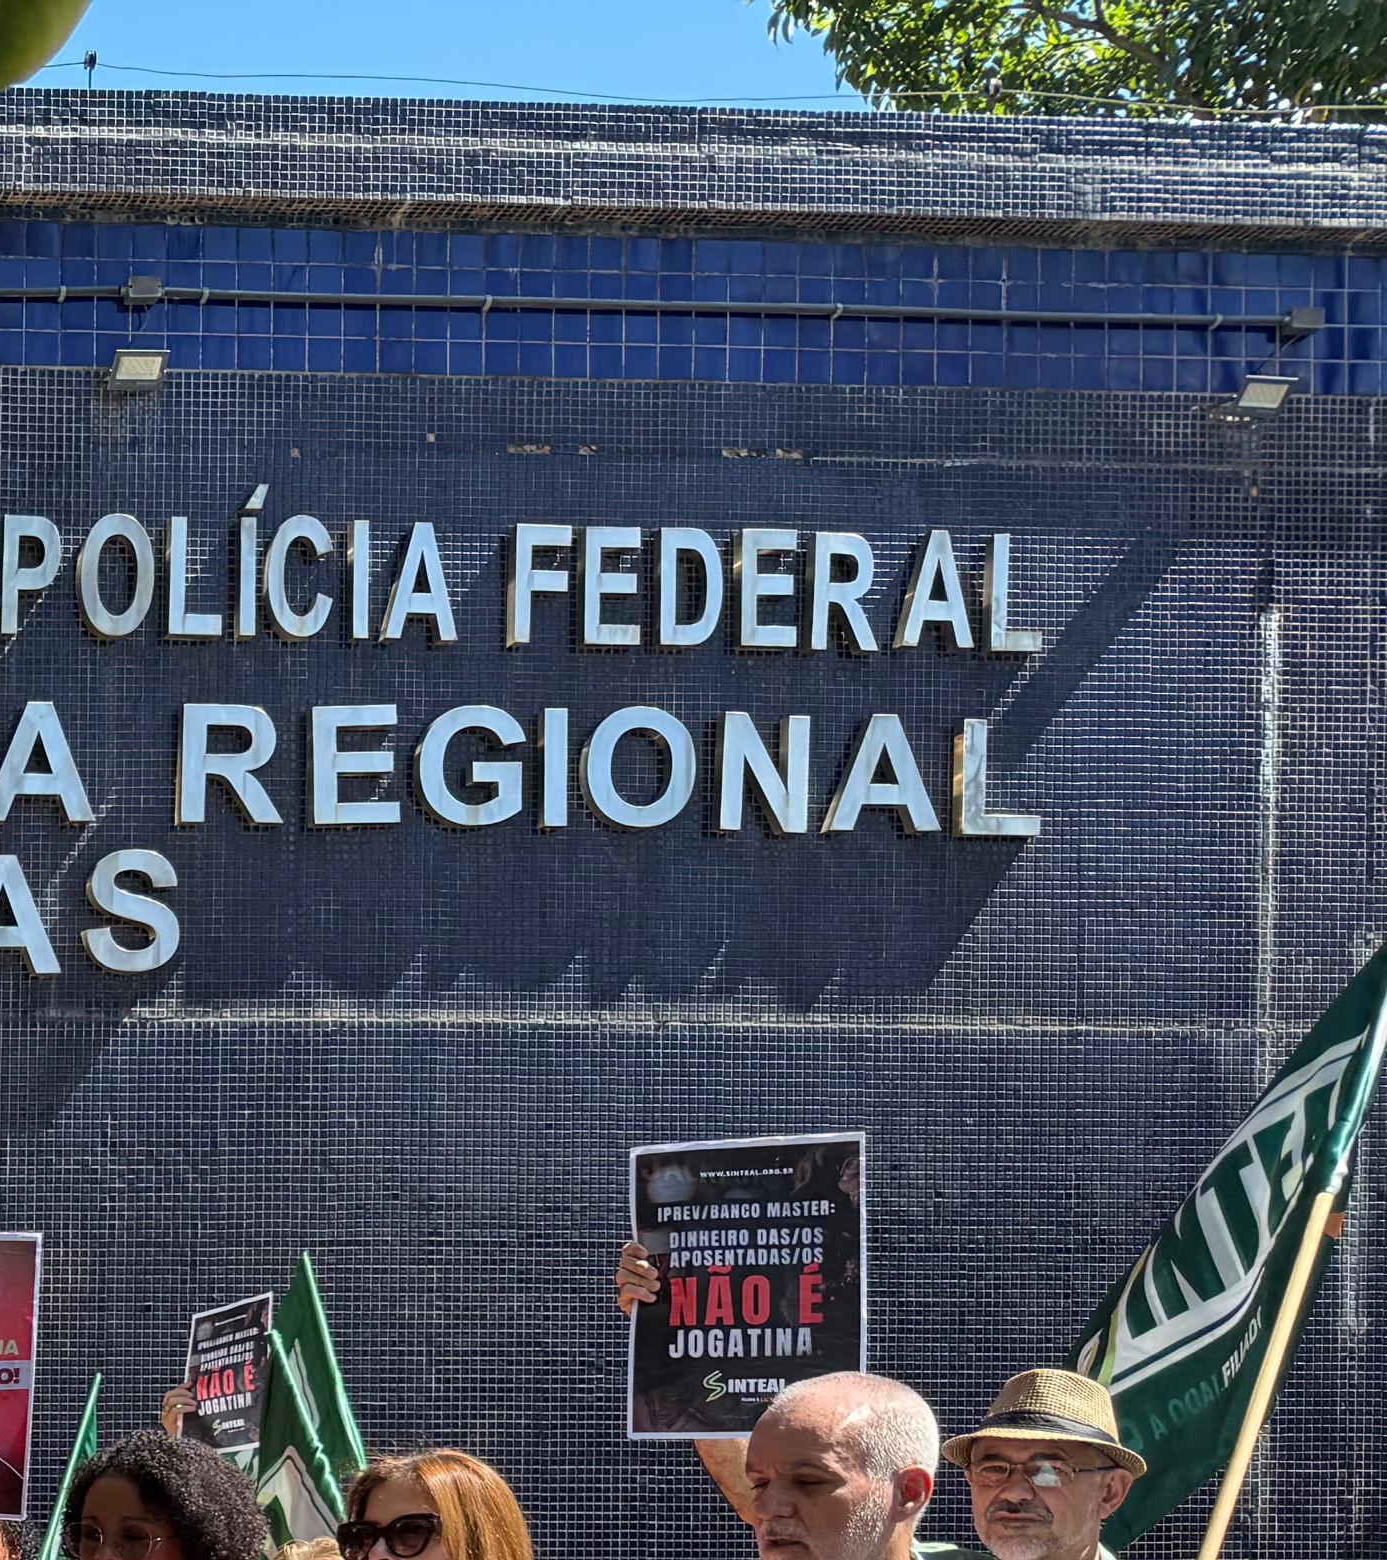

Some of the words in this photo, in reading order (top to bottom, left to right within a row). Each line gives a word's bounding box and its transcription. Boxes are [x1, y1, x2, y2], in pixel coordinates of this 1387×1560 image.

[0, 483, 459, 643] POLÍCIA
[506, 522, 1043, 653] FEDERAL
[175, 702, 1042, 839] REGIONAL
[657, 1202, 760, 1222] IPREV/BANCO
[767, 1200, 835, 1217] MASTER:
[670, 1230, 749, 1248] DINHEIRO
[757, 1227, 824, 1246] DAS/OS
[670, 1247, 824, 1268] APOSENTADAS/OS
[669, 1265, 771, 1327] NÃO
[799, 1263, 824, 1325] É
[669, 1327, 813, 1359] JOGATINA
